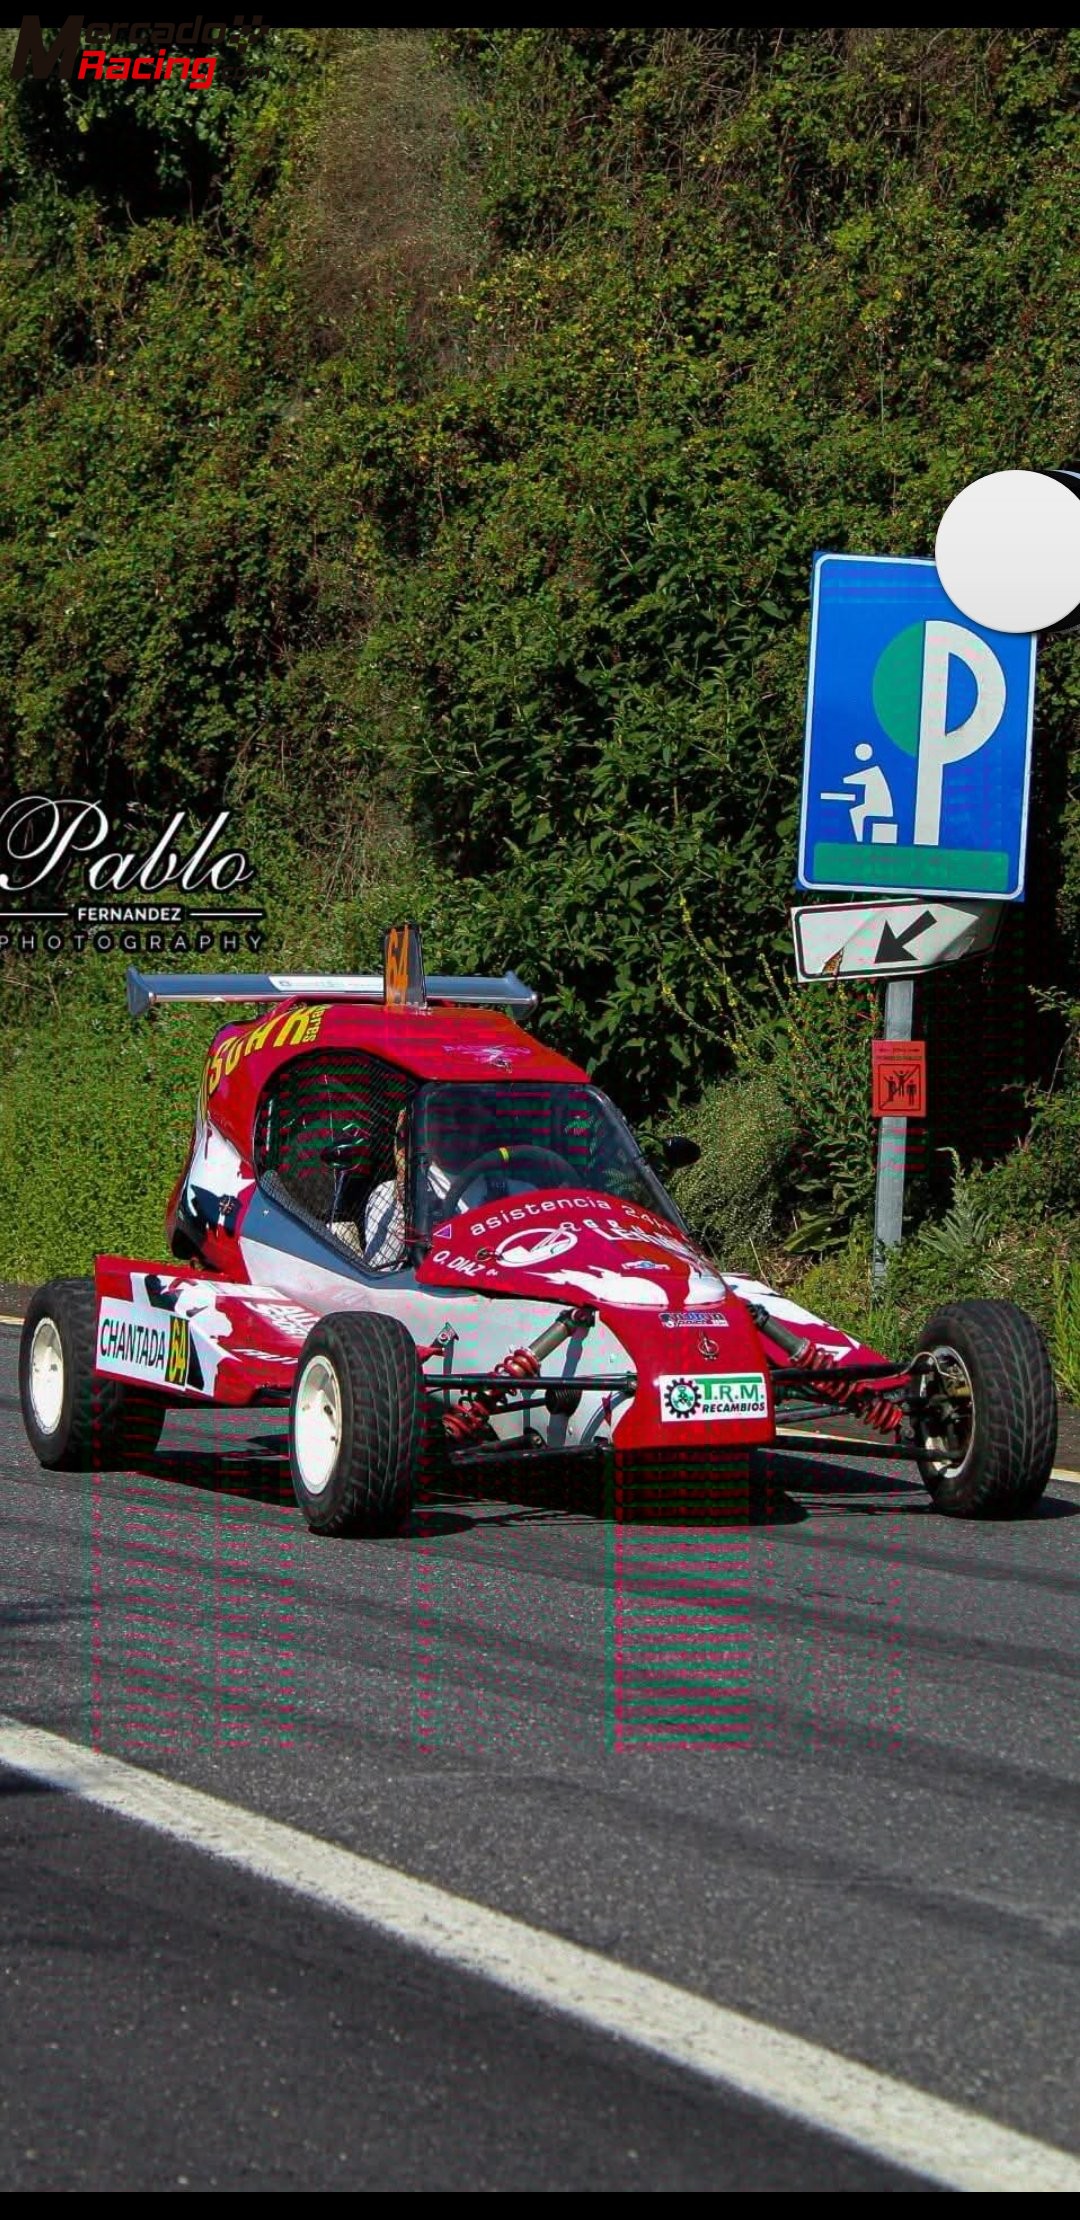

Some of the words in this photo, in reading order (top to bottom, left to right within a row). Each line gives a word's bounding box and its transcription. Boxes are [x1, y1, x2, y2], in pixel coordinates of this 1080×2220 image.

[913, 620, 1007, 846] P
[385, 924, 409, 1012] 64
[469, 1196, 612, 1237] asistencia
[447, 1256, 486, 1277] DIAZ
[100, 1318, 165, 1371] CHANTADA
[168, 1317, 187, 1384] 64
[694, 1376, 765, 1403] T.R.M.
[702, 1401, 765, 1414] RECAMBIOS
